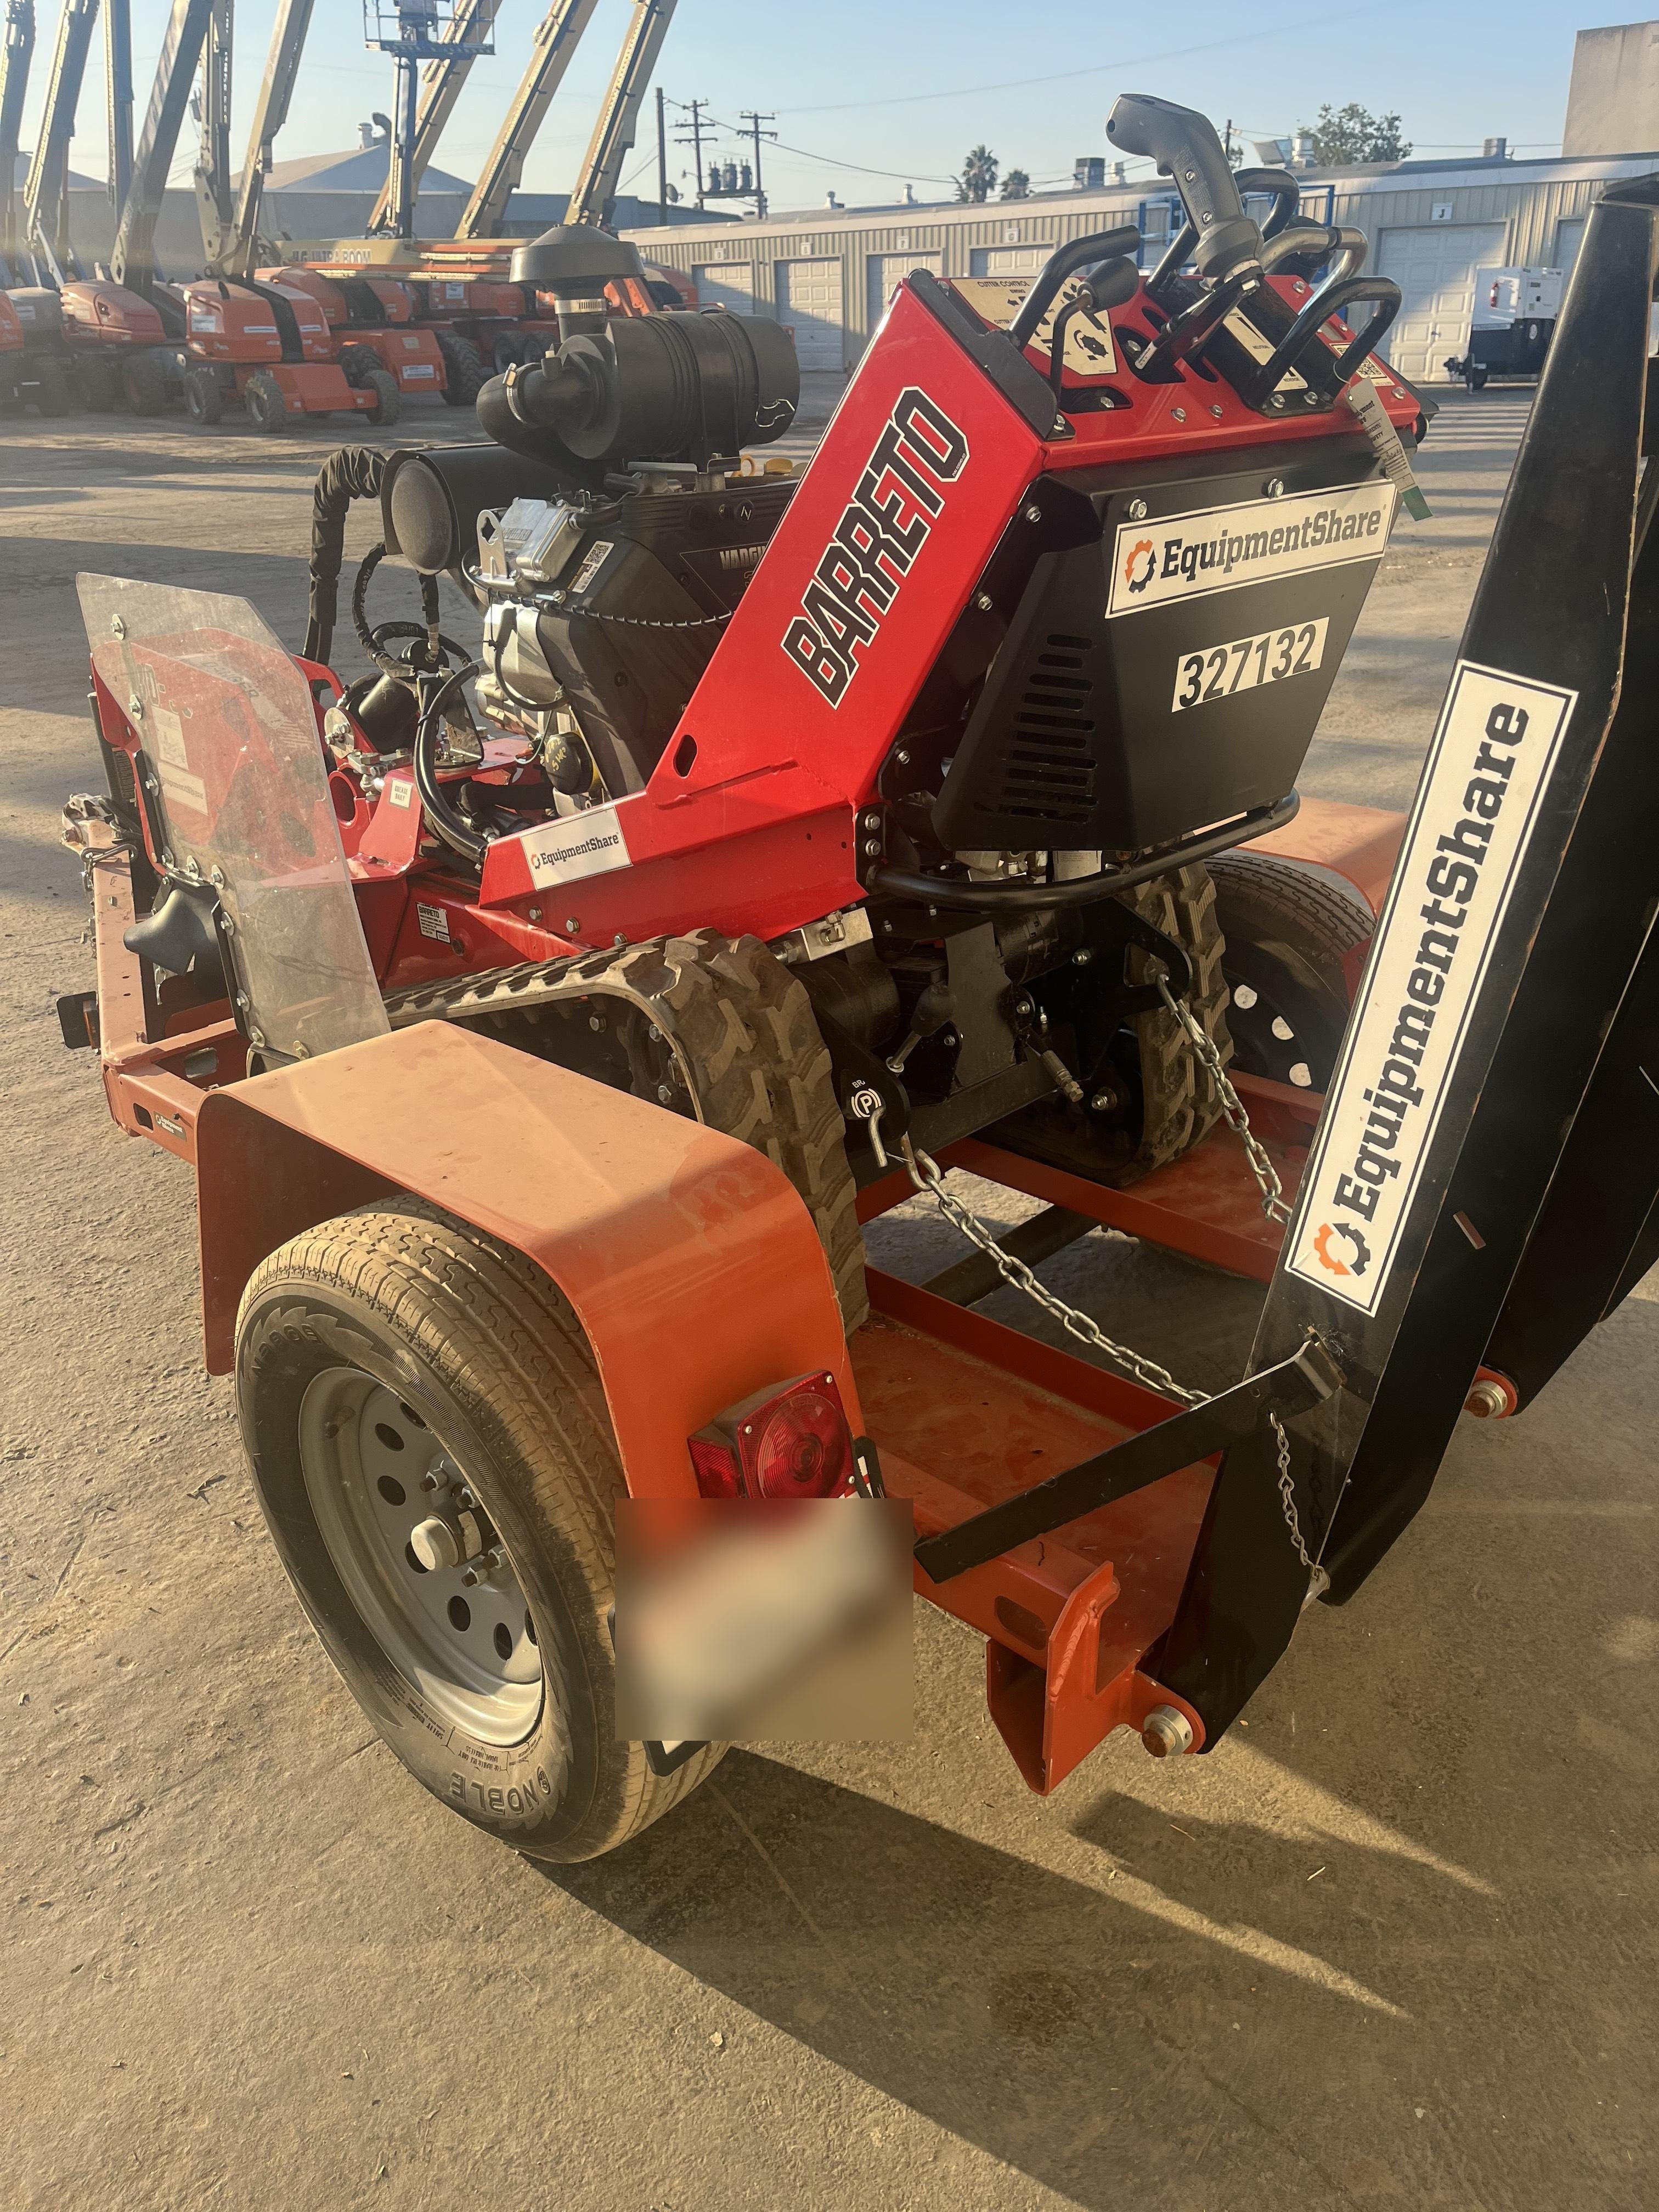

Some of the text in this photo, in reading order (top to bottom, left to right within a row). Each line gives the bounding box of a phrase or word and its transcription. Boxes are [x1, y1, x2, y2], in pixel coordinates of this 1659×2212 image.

[1439, 208, 1446, 218] J
[341, 249, 371, 264] BOOM
[780, 386, 970, 710] BARRETO
[1160, 508, 1382, 583] EquipmentShare
[1178, 623, 1317, 709] 327132
[539, 834, 620, 866] EquipmentShare
[418, 905, 440, 918] BARRETO
[1331, 702, 1530, 1223] EquipmentShare
[860, 1095, 872, 1114] P
[449, 1769, 540, 1816] NOBLE
